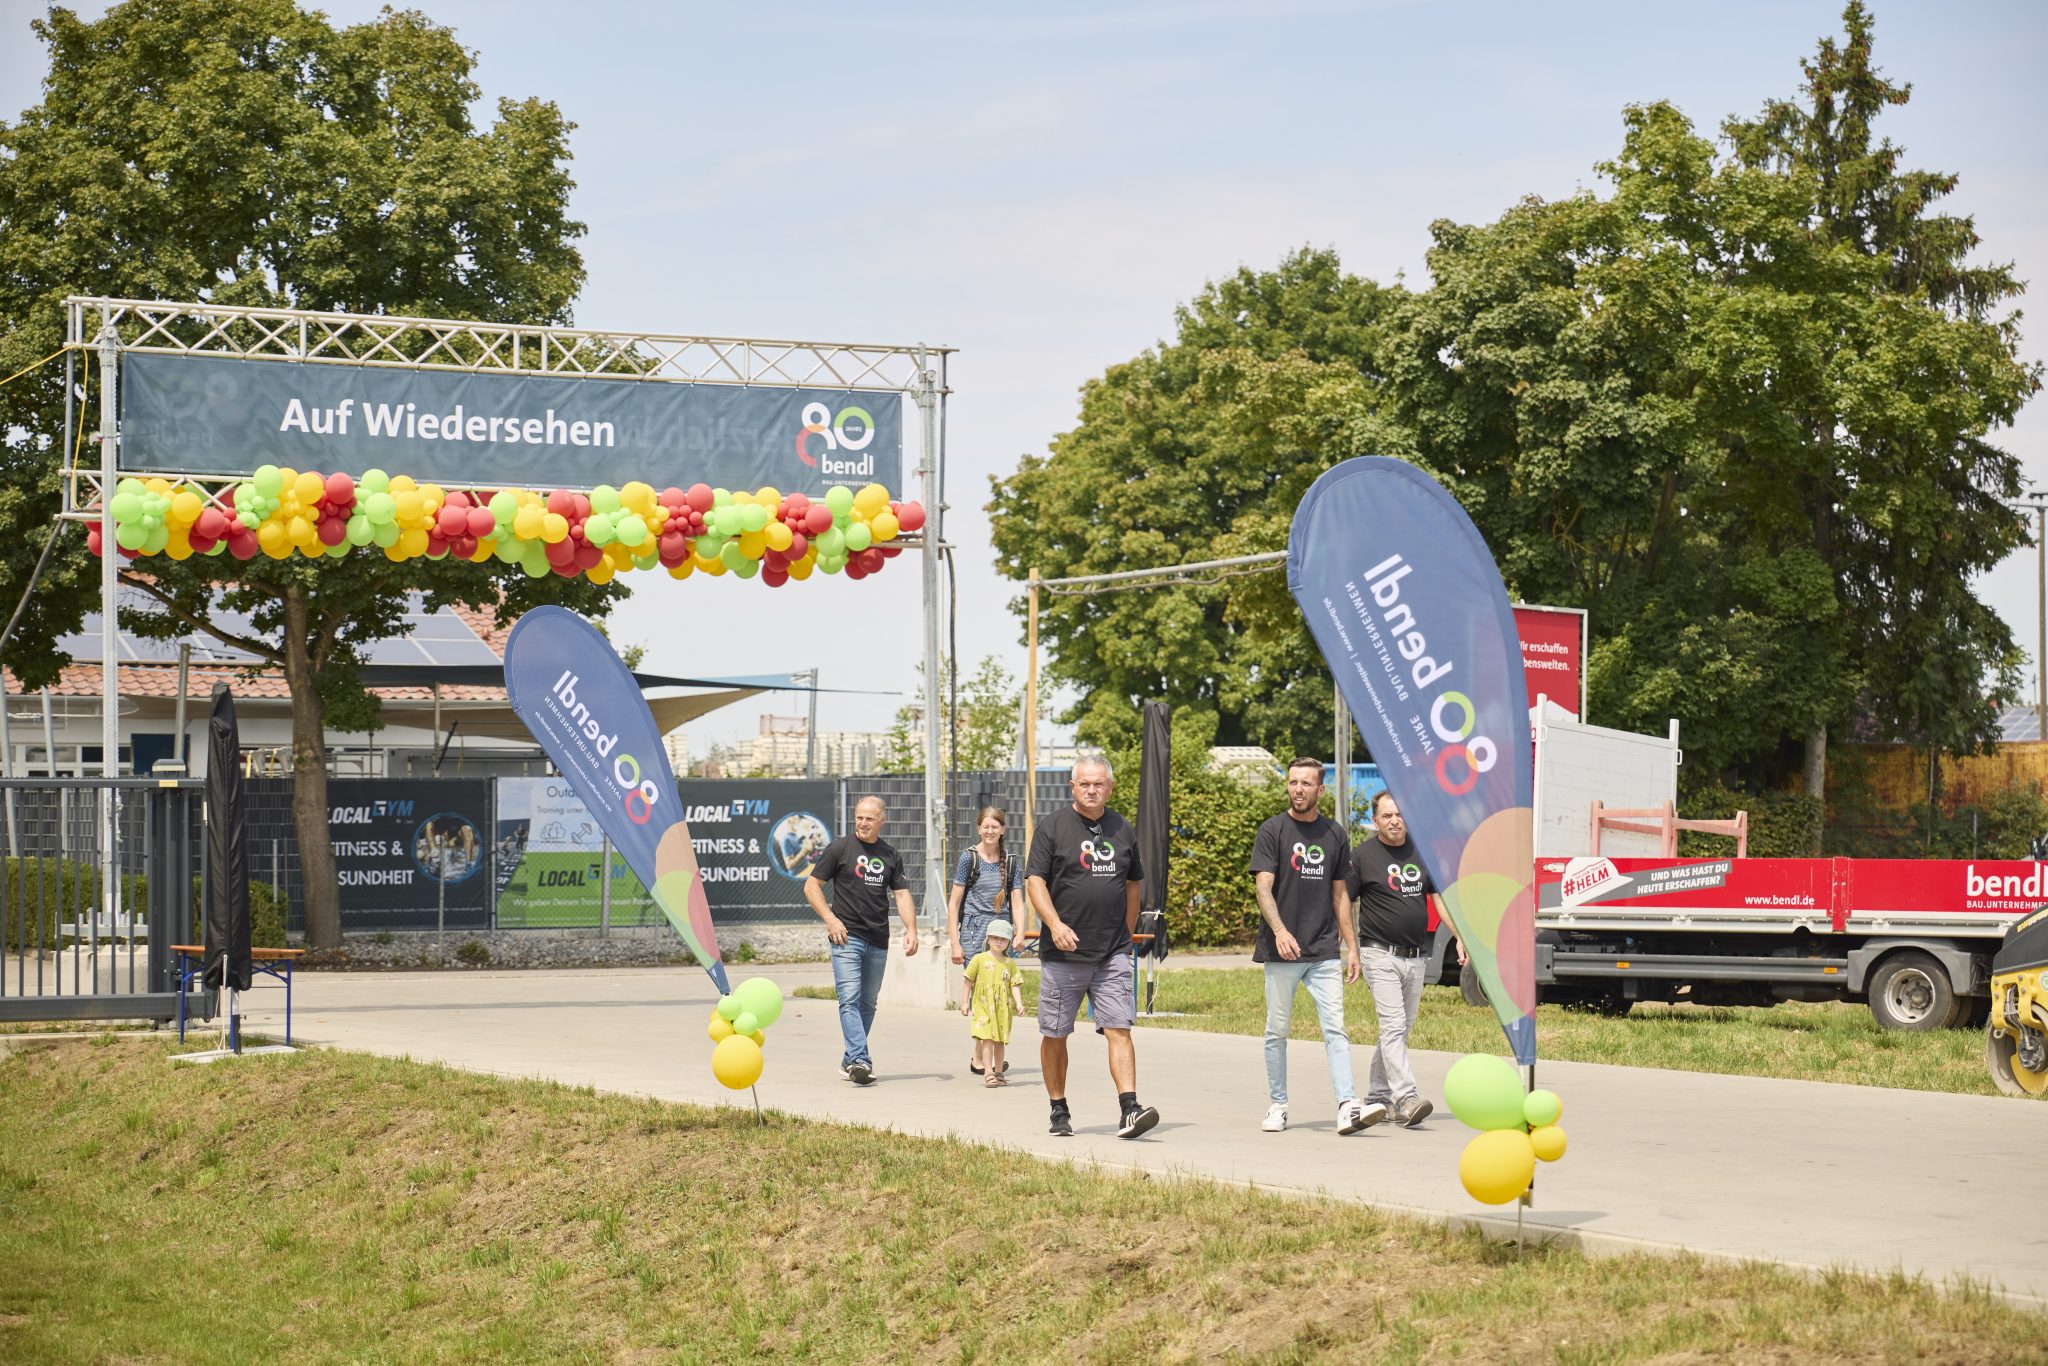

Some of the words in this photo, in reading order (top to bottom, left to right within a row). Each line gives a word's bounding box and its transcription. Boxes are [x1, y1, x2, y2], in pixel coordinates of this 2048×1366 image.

[280, 398, 354, 434] Auf
[362, 402, 615, 447] Wiedersehen
[845, 425, 863, 433] JAHRE
[821, 453, 874, 475] bendl
[1529, 642, 1568, 654] erschaffen
[1523, 657, 1570, 671] benswelten.
[546, 785, 576, 798] Outd
[372, 800, 415, 817] GYM
[537, 806, 565, 815] Training
[685, 805, 732, 823] LOCAL
[731, 799, 771, 816] GYM
[391, 840, 404, 856] &
[748, 838, 761, 854] &
[700, 866, 771, 882] SUNDHEIT
[1092, 861, 1116, 872] bendl
[1301, 864, 1324, 875] bendl
[1651, 870, 1670, 881] UND
[1671, 867, 1690, 879] WAS
[1691, 864, 1714, 876] HAST
[1715, 863, 1728, 873] DU
[338, 869, 415, 886] SUNDHEIT
[538, 870, 586, 888] LOCAL
[587, 863, 627, 880] GM
[864, 873, 884, 883] bendl
[1563, 866, 1610, 896] #HELM
[1966, 861, 2048, 897] bendl
[1401, 882, 1423, 893] bendl
[1637, 882, 1664, 894] HEUTE
[1665, 875, 1721, 891] ERSCHAFFEN?
[1744, 894, 1815, 906] www.bendl.de
[1966, 900, 2047, 909] BAU.UNTERNEHME
